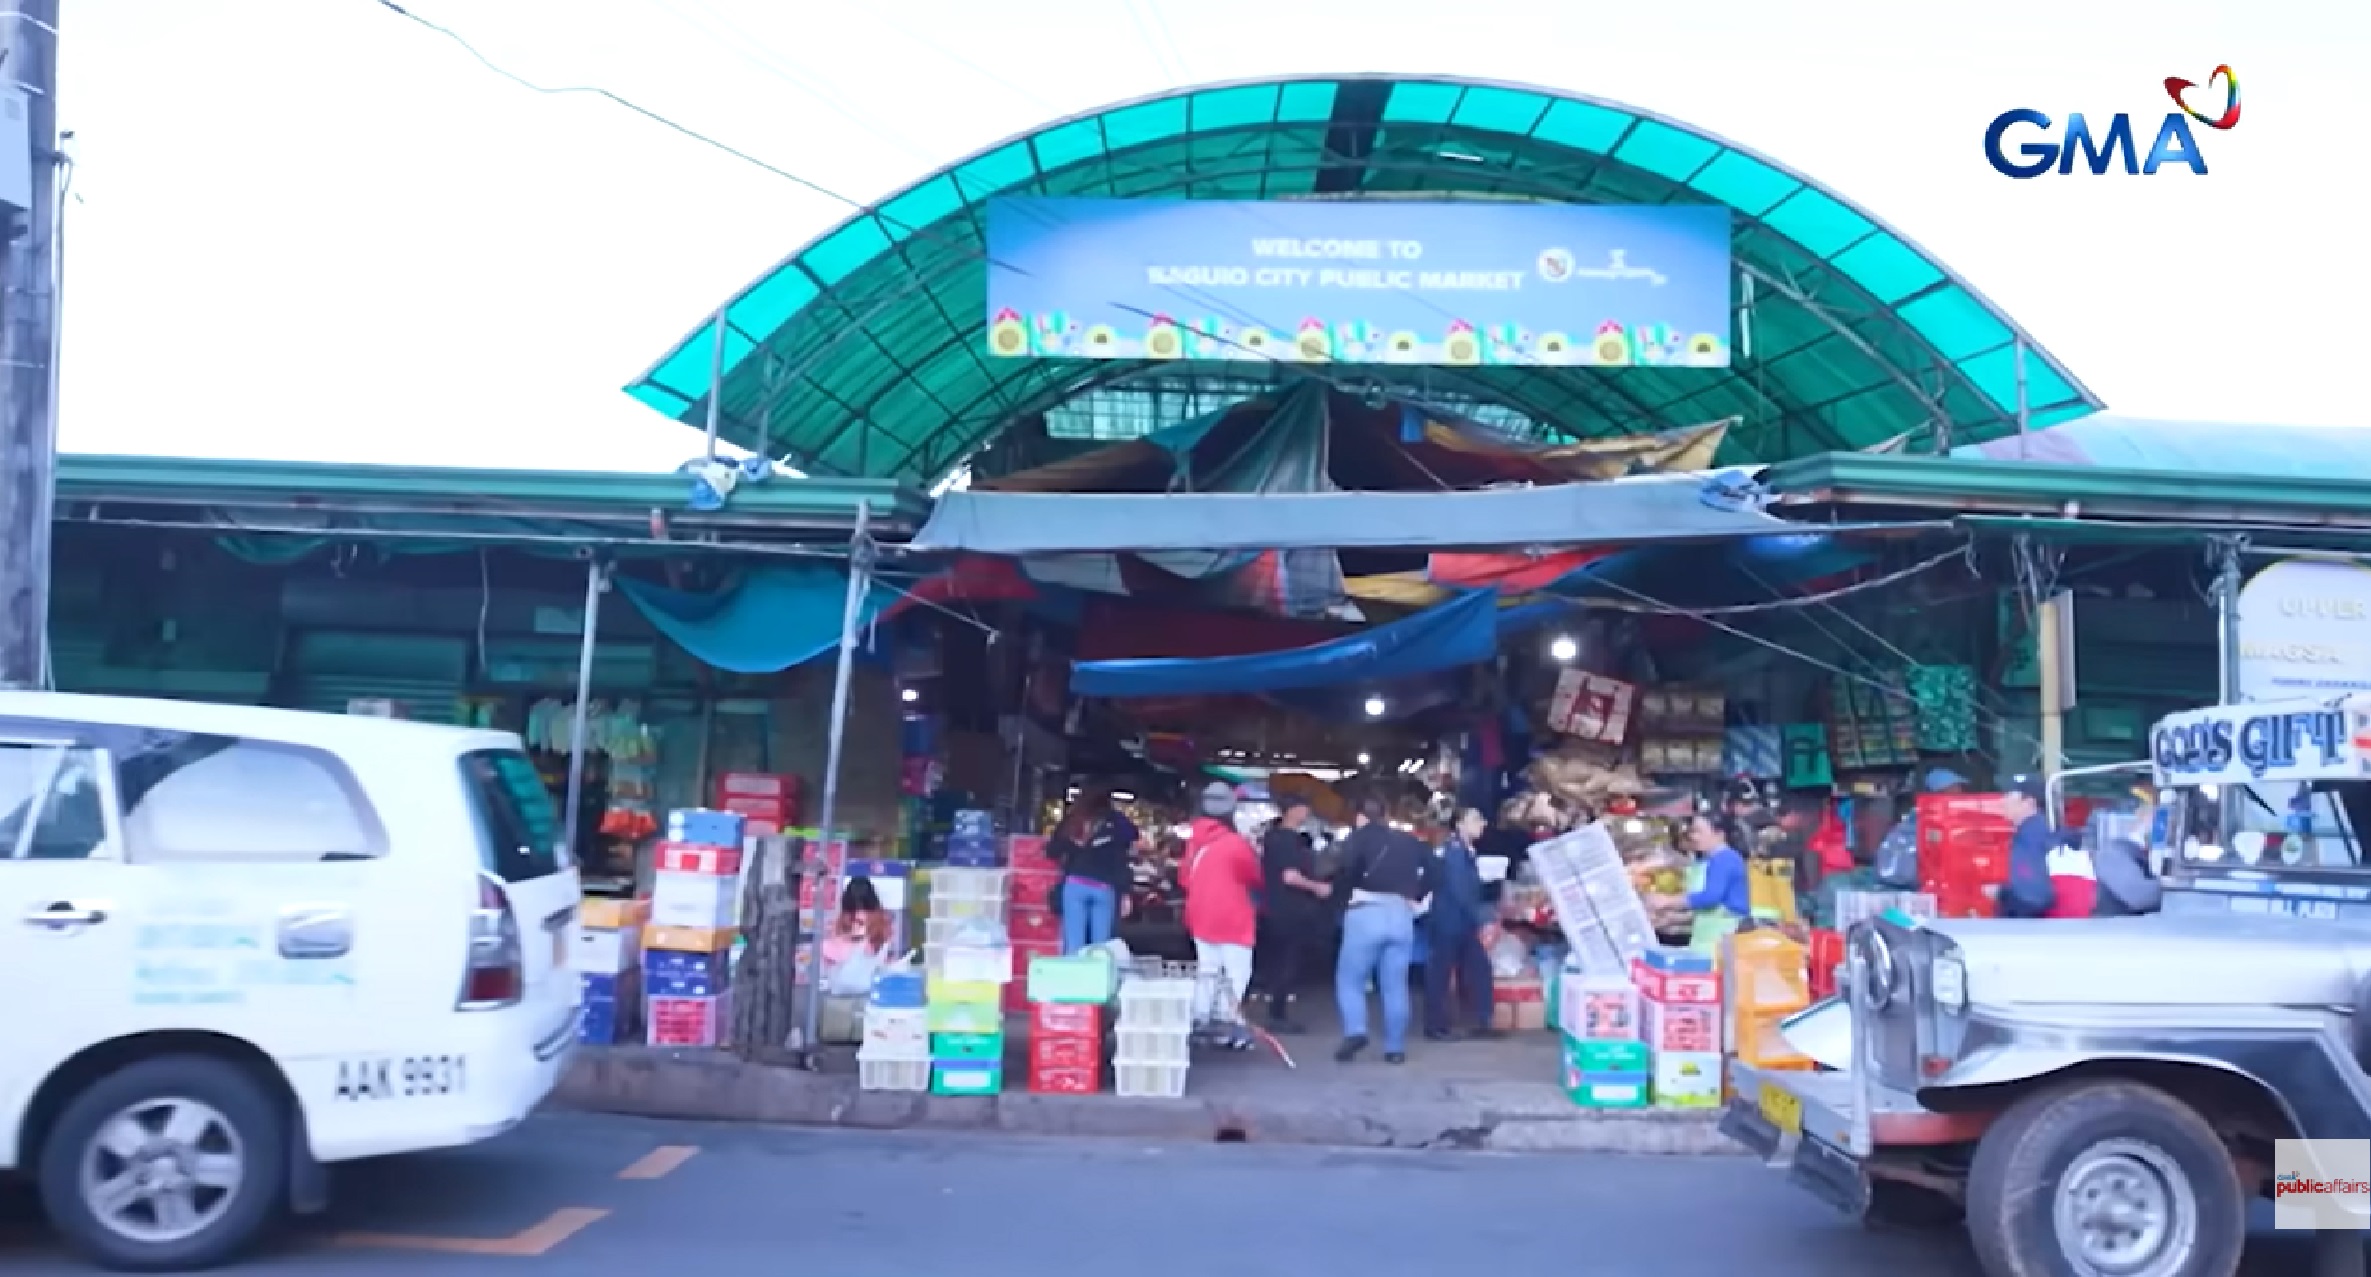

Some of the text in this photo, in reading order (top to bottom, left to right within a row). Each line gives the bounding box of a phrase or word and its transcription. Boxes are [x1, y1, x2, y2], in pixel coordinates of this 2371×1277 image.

[1251, 238, 1423, 259] WELCOME TO
[1256, 267, 1311, 287] CITY
[1319, 268, 1413, 289] PUBLIC
[1419, 270, 1527, 290] MARKET
[2239, 711, 2347, 778] GIFT
